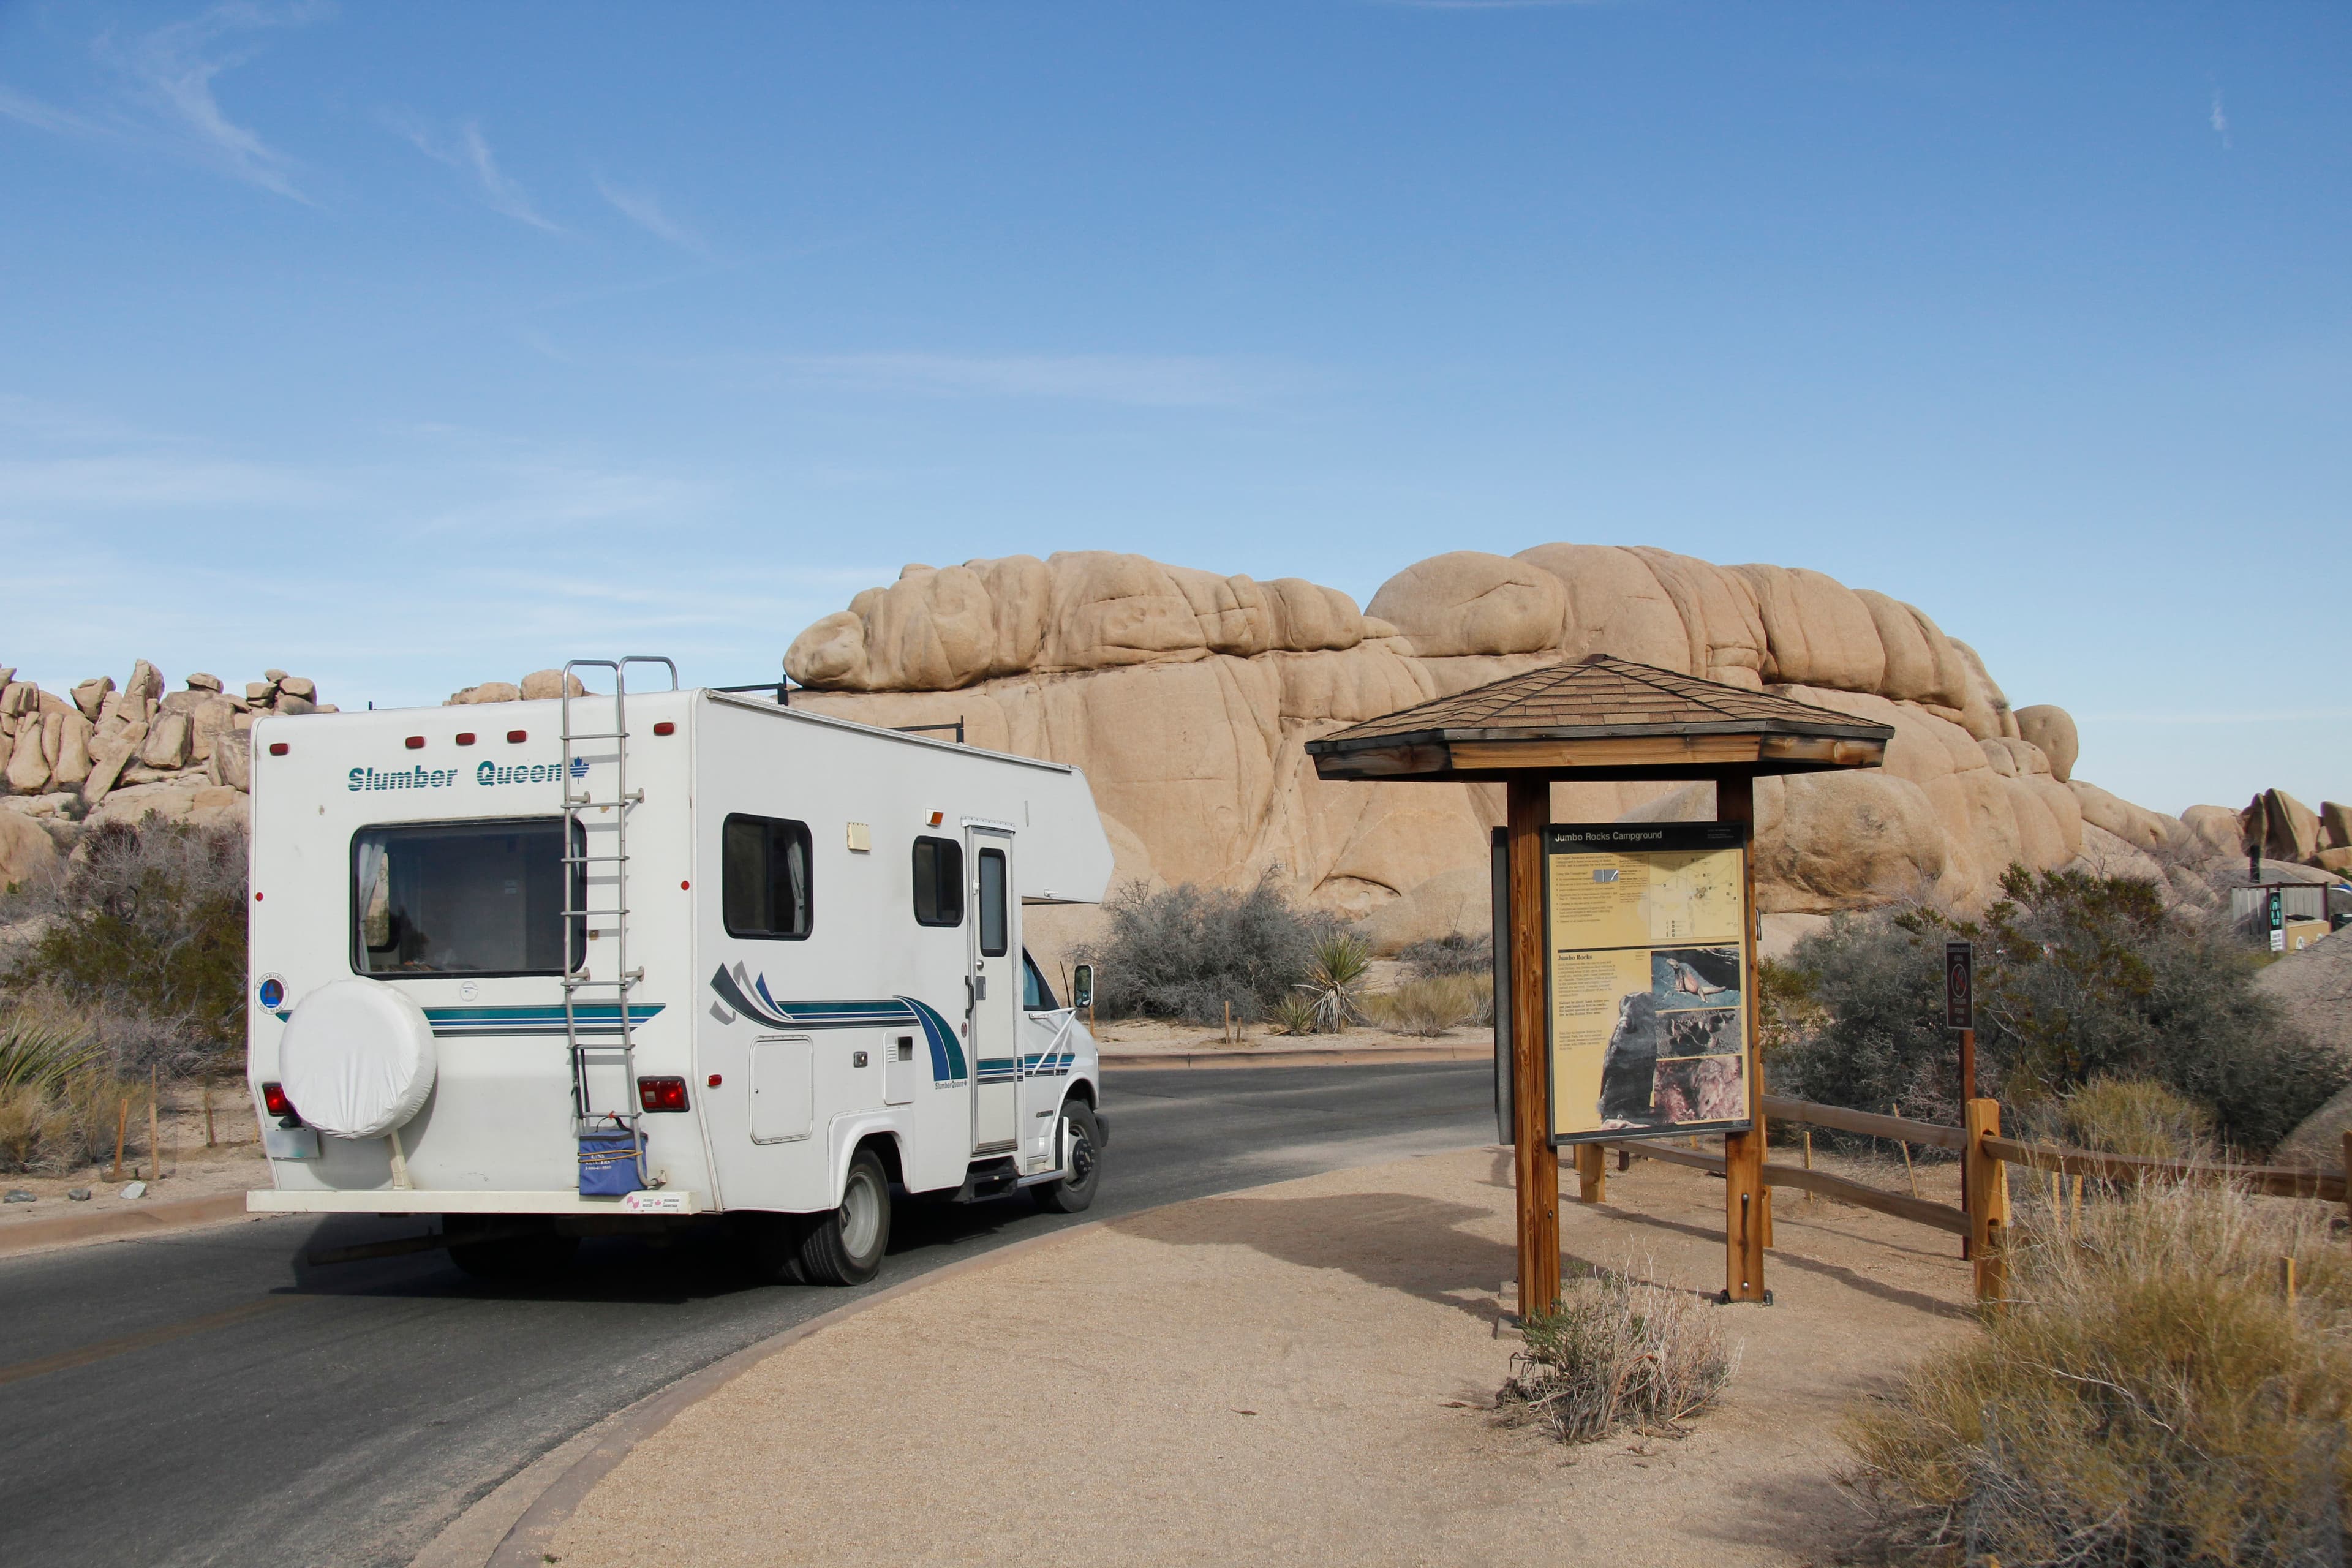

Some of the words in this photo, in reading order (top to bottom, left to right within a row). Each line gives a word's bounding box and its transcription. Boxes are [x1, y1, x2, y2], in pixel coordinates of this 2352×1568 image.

[347, 765, 458, 791] Slumber
[477, 760, 562, 787] Queen
[1555, 832, 1583, 842] Jumbo
[1585, 832, 1610, 840] Rocks
[1612, 831, 1662, 842] Campground
[255, 974, 288, 990] VAGABUNDOS
[259, 1004, 268, 1012] DEL
